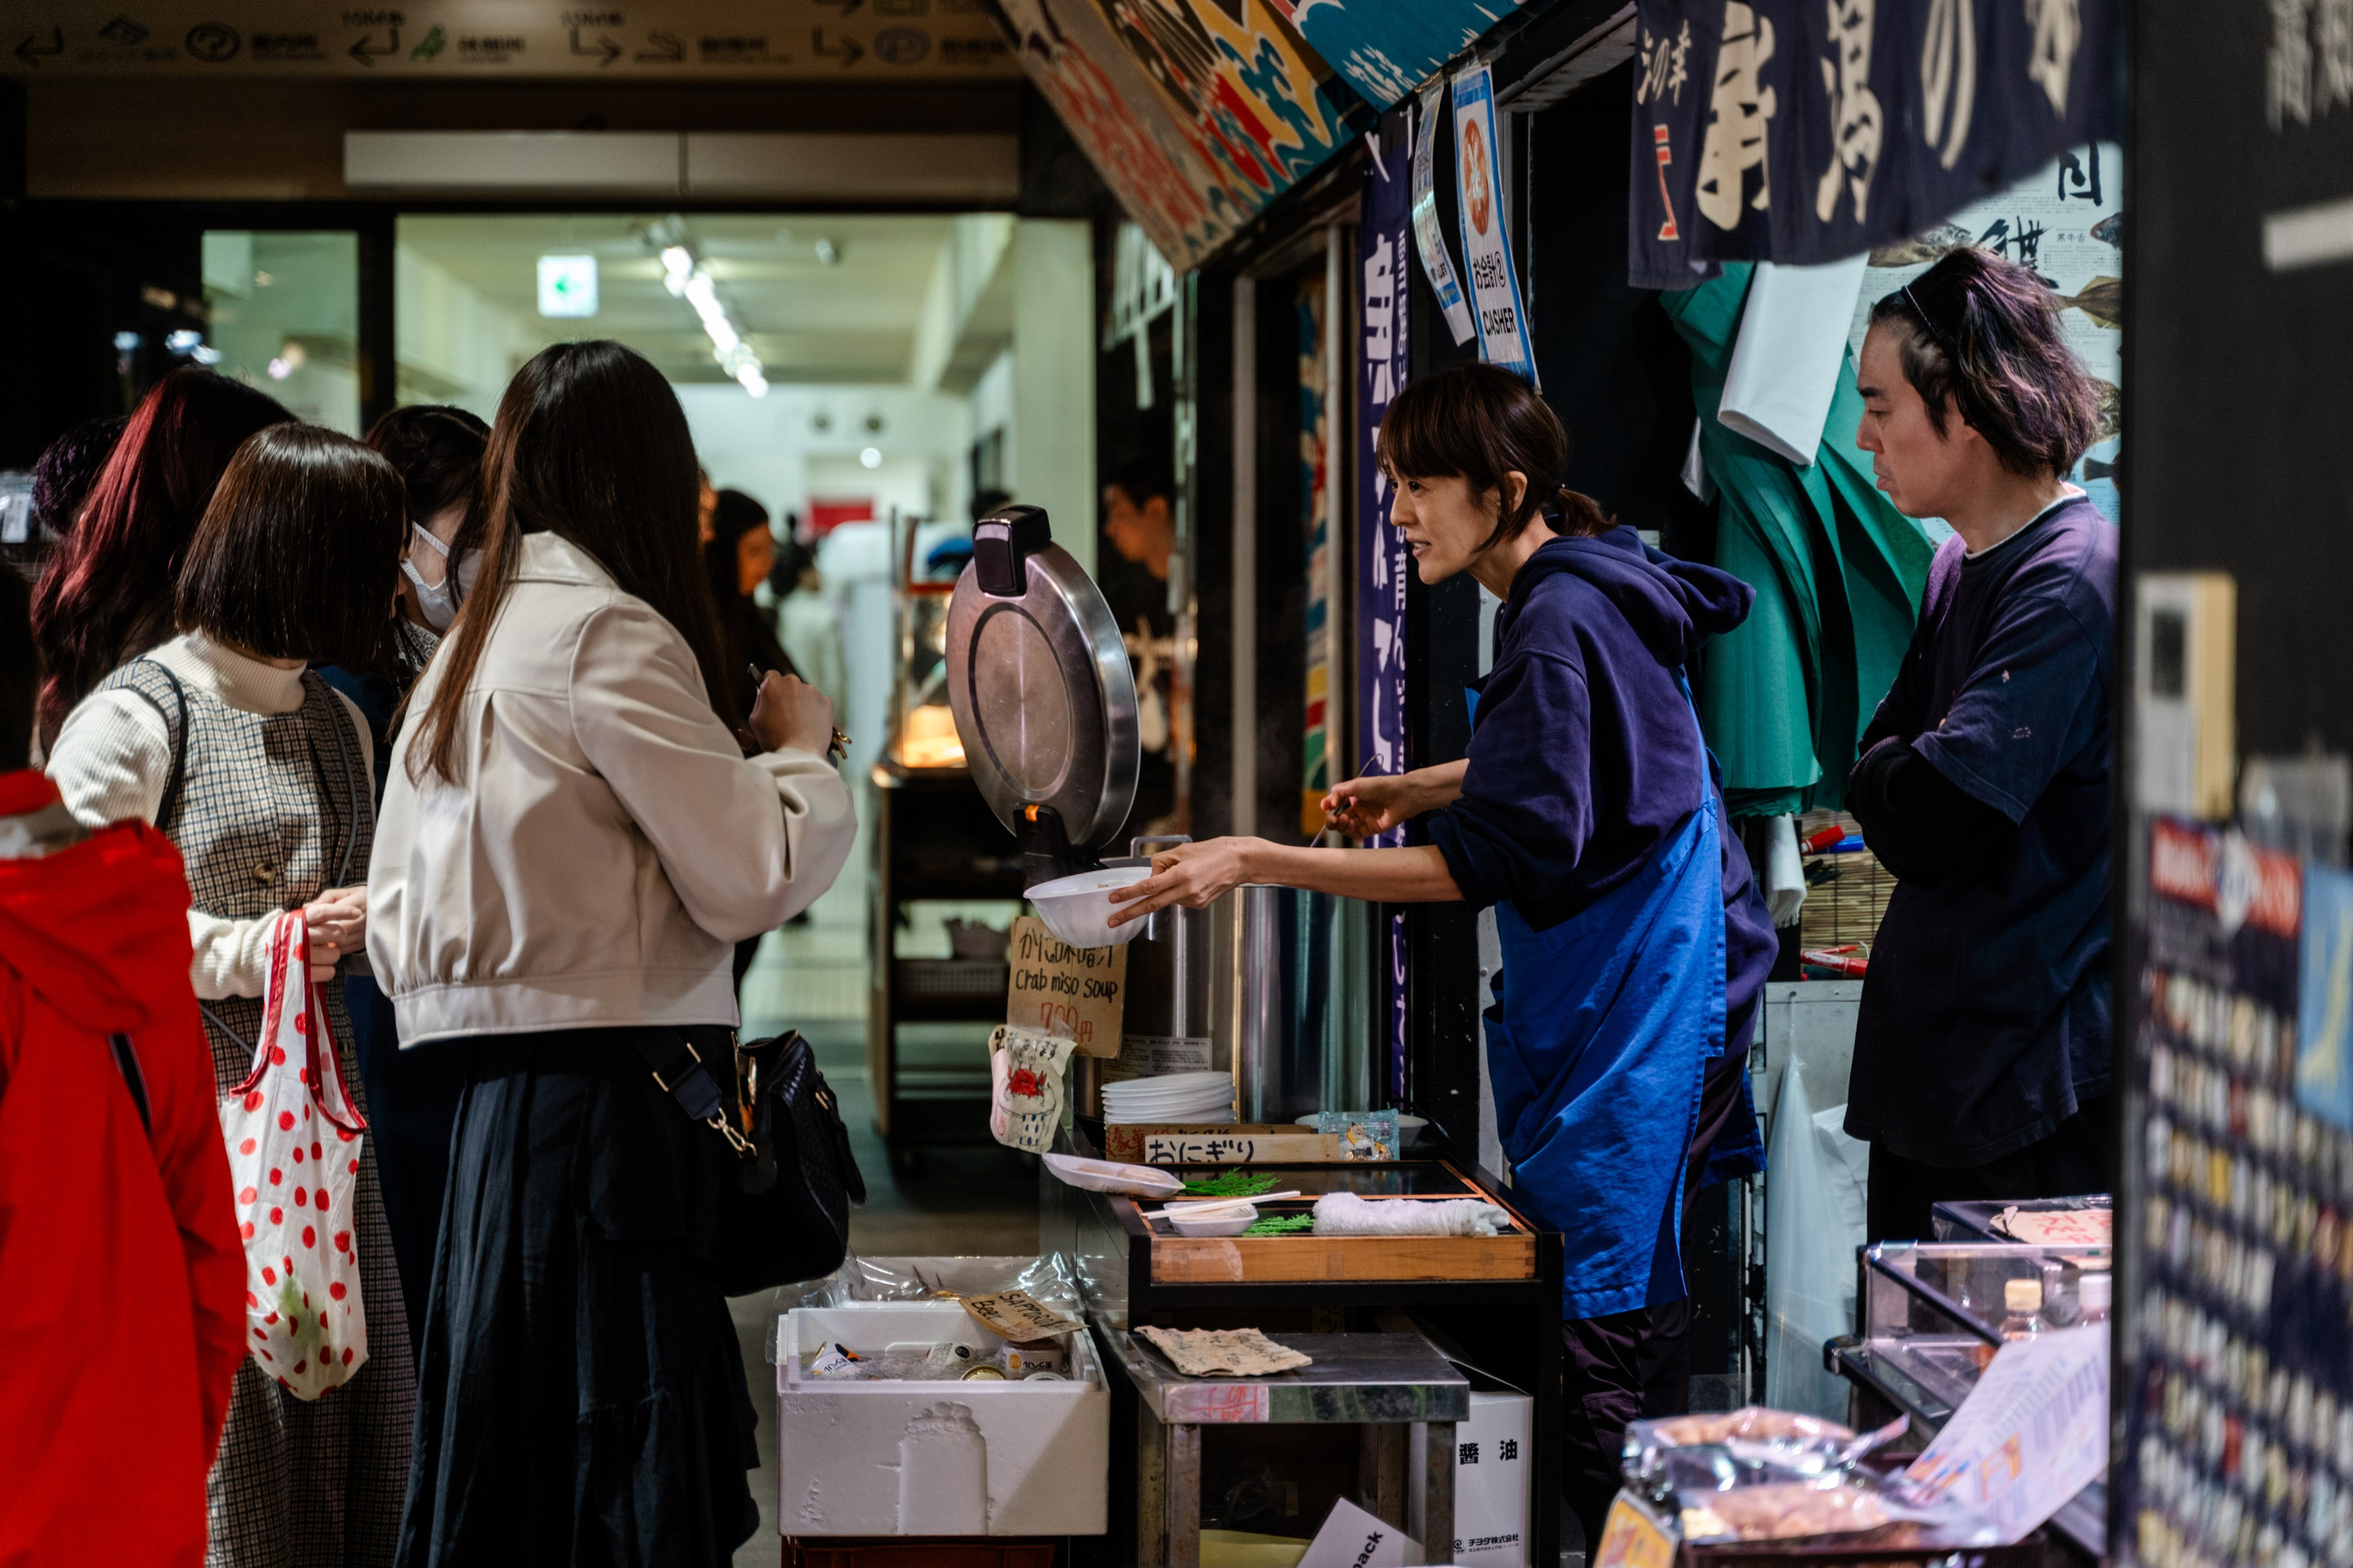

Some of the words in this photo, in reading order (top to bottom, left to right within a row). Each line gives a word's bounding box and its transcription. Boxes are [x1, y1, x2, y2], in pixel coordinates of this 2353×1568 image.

[1483, 308, 1517, 336] CASHER
[1016, 968, 1048, 991] Crab
[1051, 971, 1080, 995] miso
[1083, 977, 1119, 1004] soup
[1149, 1140, 1255, 1164] おにぎり
[1023, 1360, 1052, 1369] 黒ラベル
[1469, 1533, 1518, 1547] チヨダ株式会社
